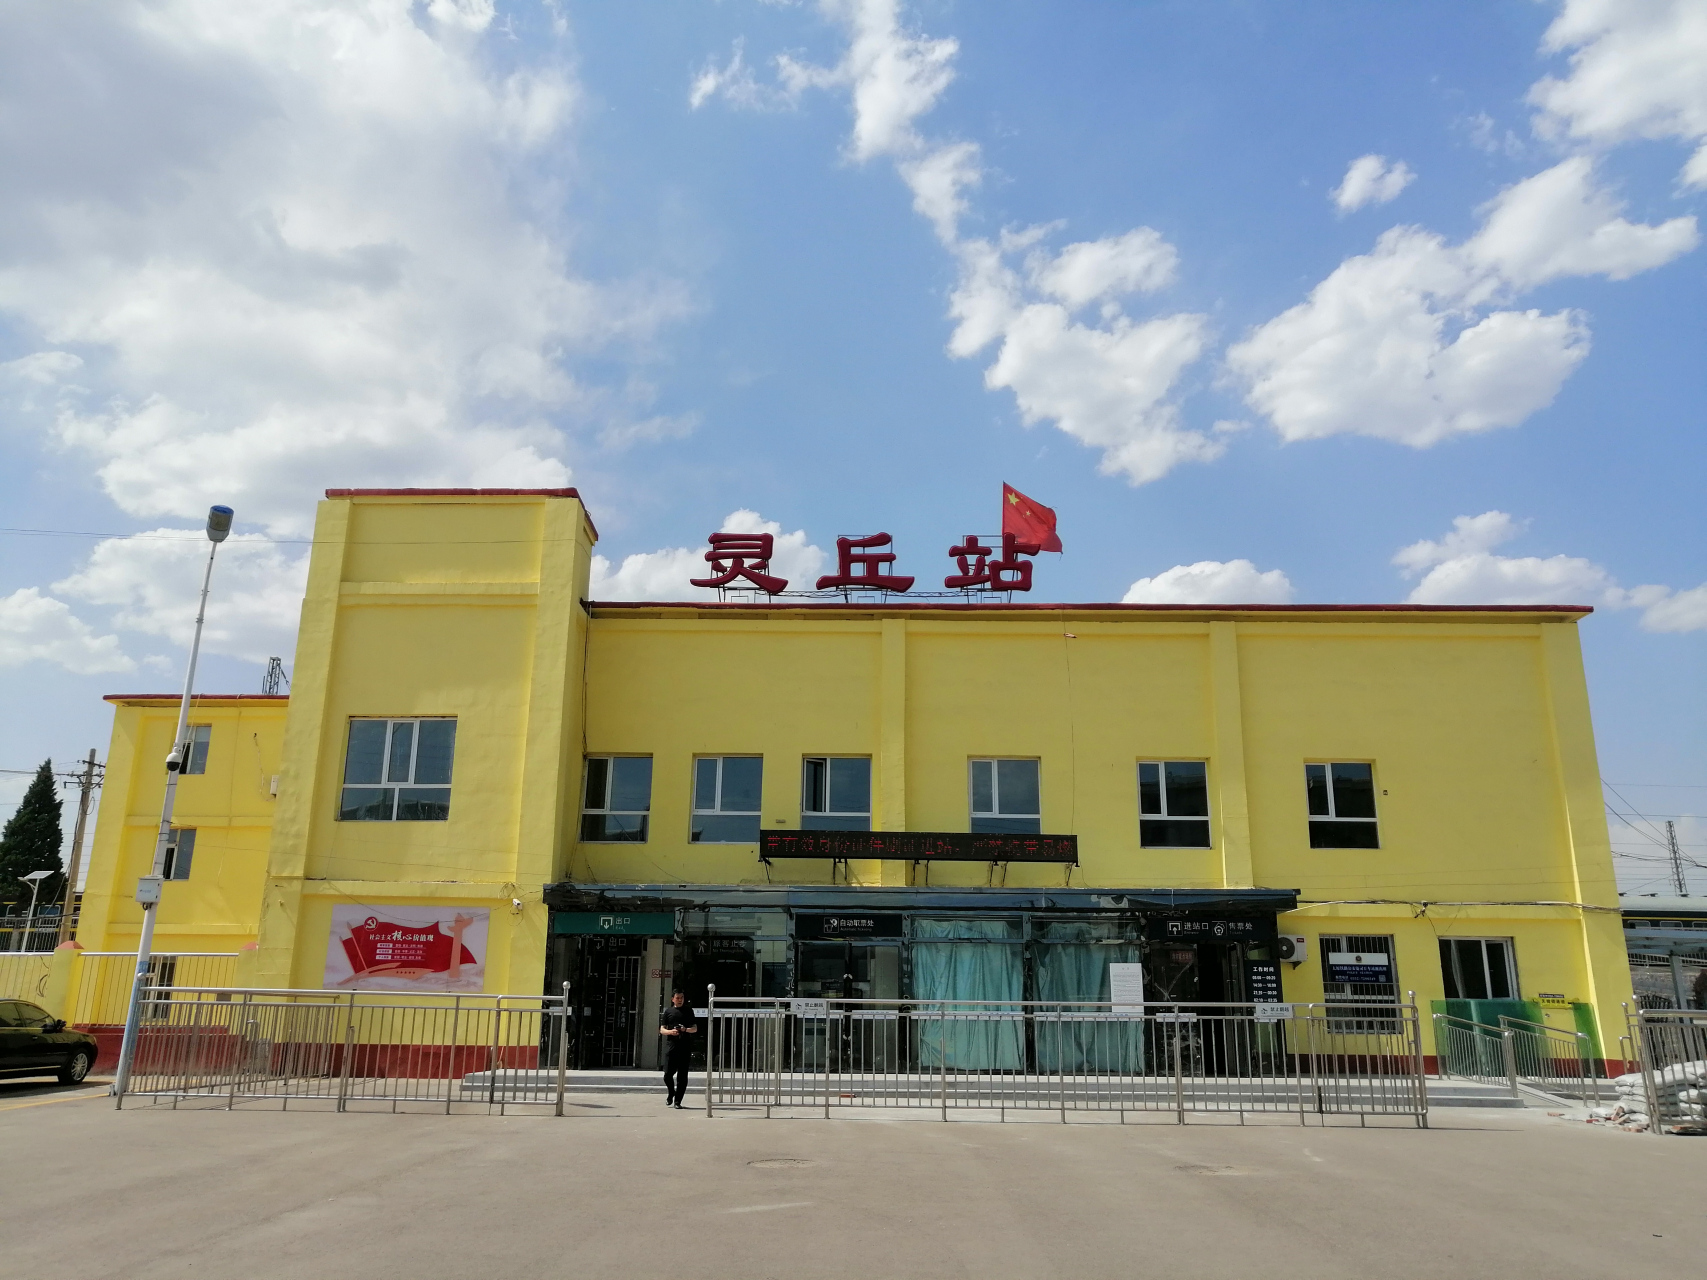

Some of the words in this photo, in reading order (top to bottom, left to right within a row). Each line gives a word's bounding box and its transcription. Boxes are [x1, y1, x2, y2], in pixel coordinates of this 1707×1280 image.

[690, 532, 1041, 594] 灵丘站
[615, 917, 631, 925] 出口
[1183, 922, 1209, 931] 进站口
[1228, 922, 1253, 931] 售票处
[369, 930, 434, 942] 社会主义核心价值观
[609, 936, 627, 947] 出口
